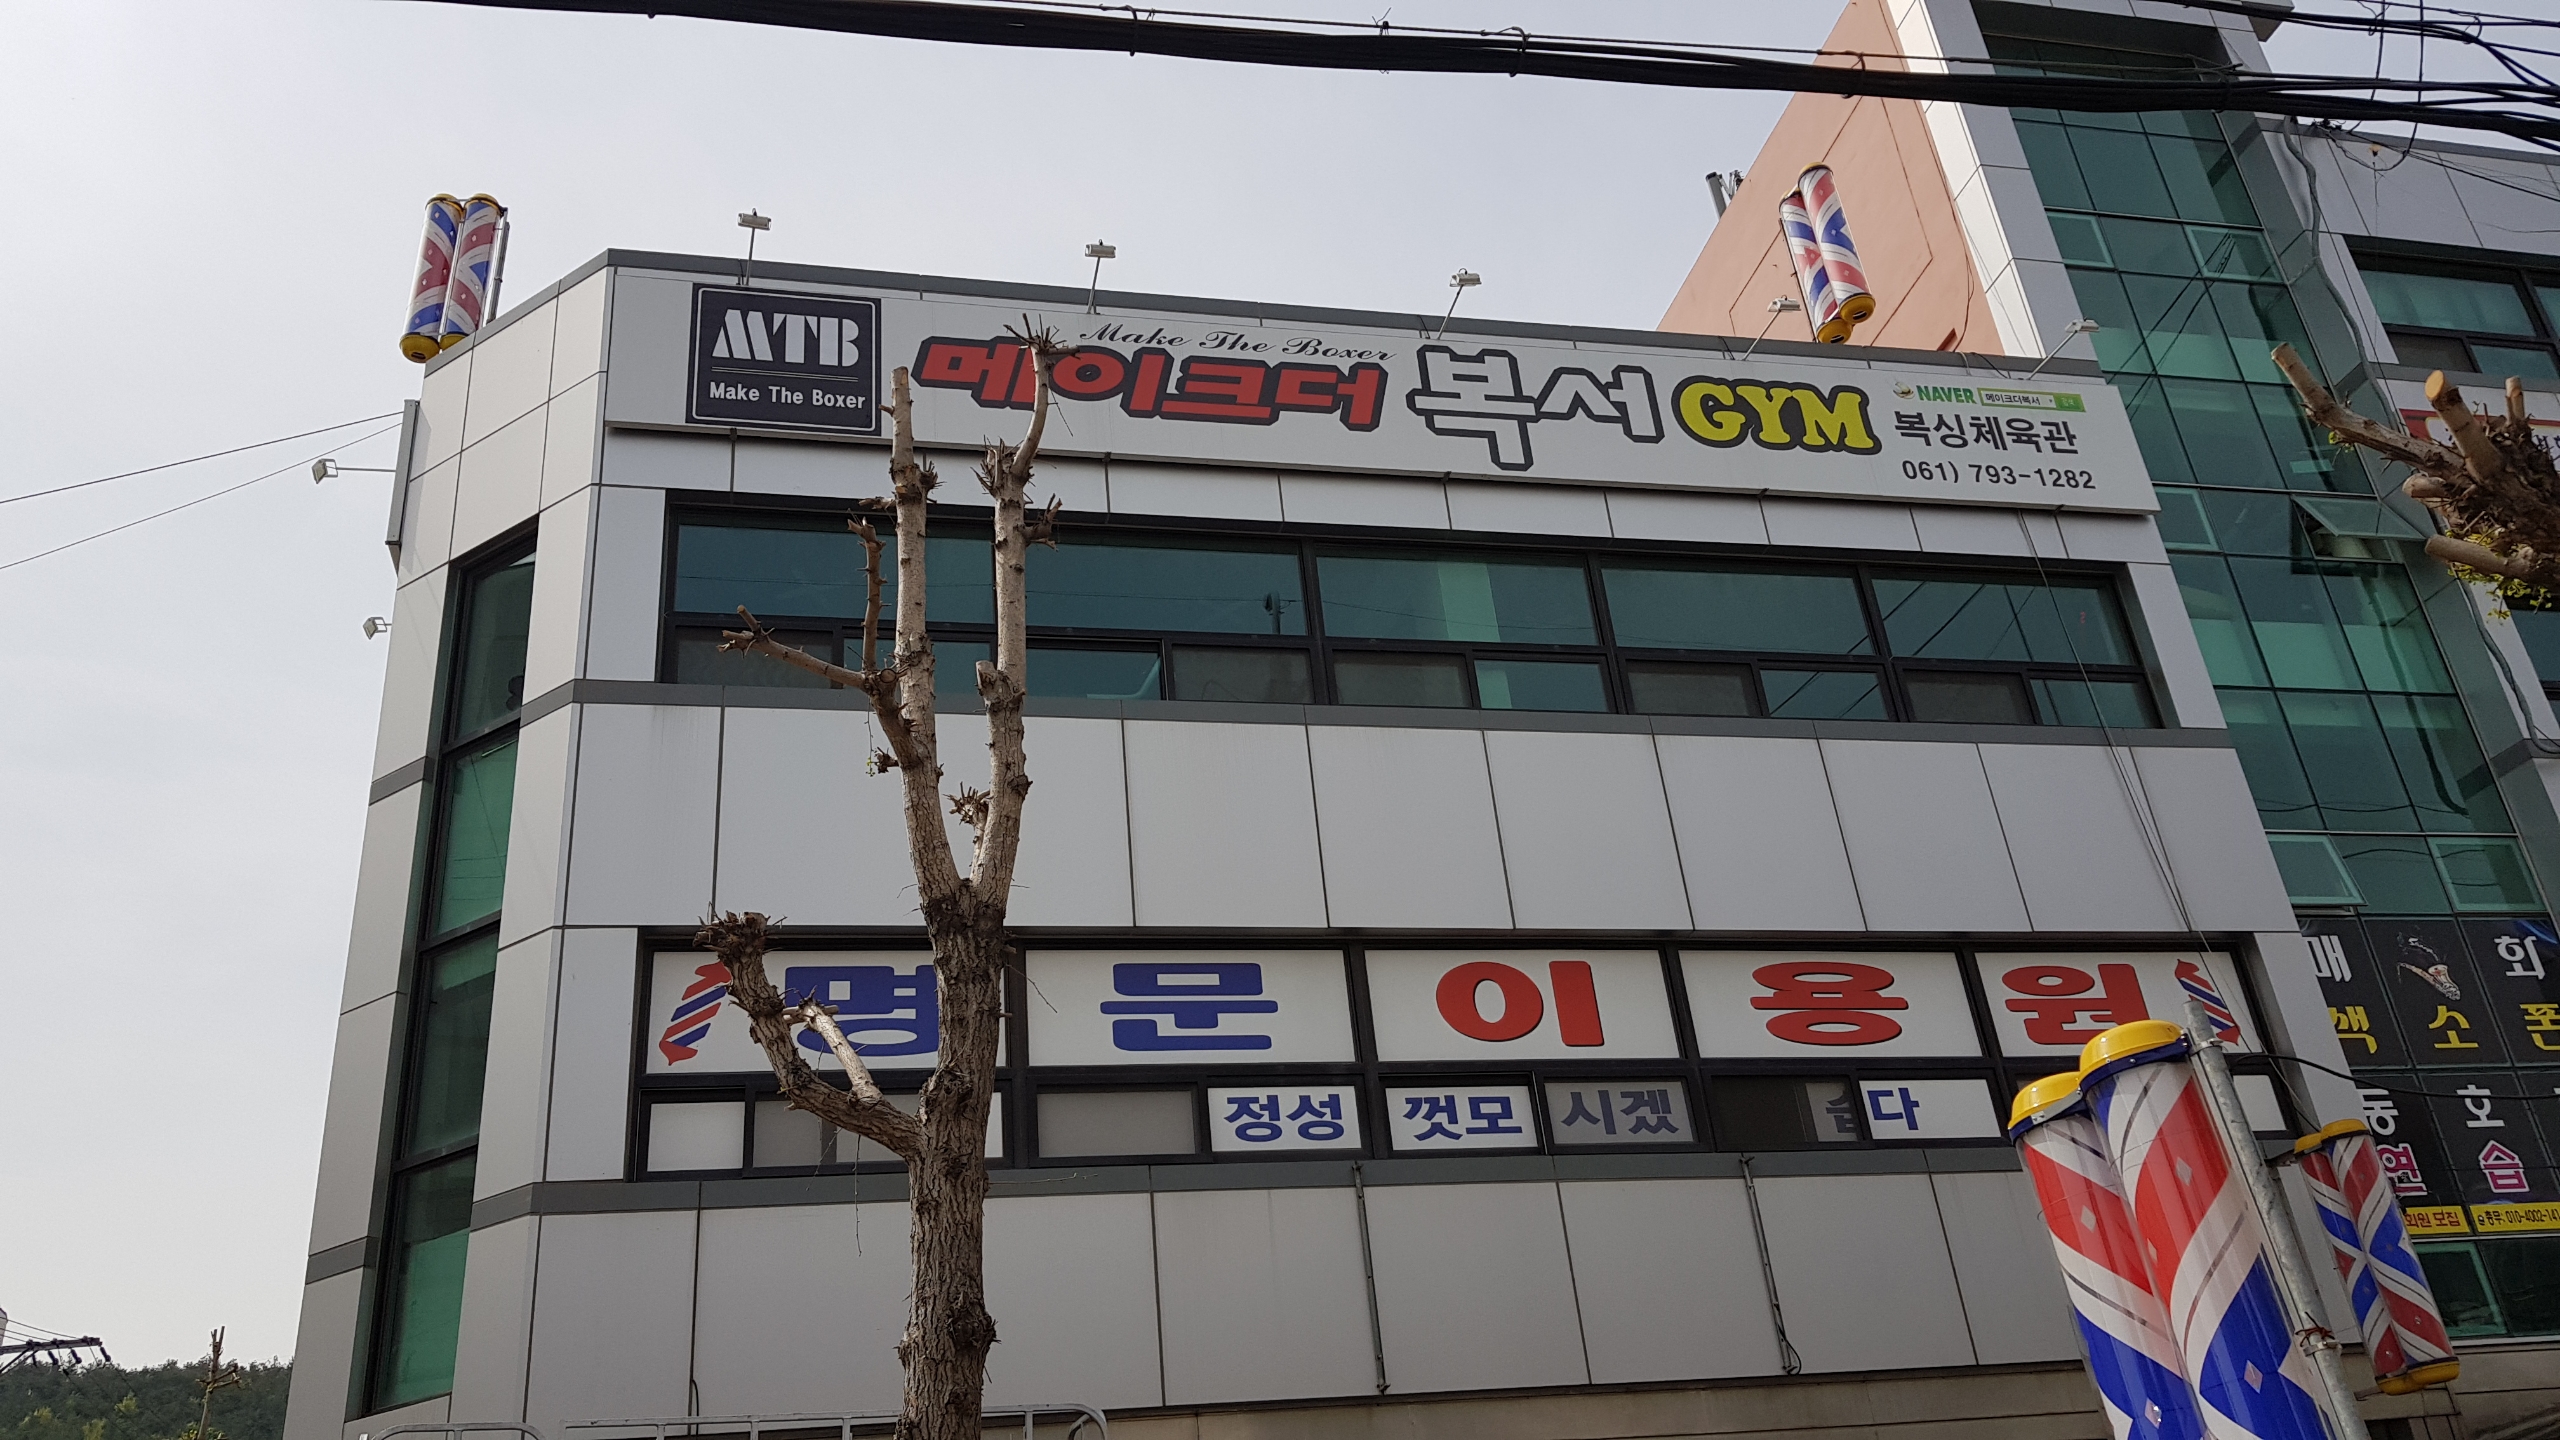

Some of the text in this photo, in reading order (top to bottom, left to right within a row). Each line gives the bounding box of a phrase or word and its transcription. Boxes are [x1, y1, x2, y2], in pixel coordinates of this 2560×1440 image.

[712, 309, 860, 368] MTB
[1080, 323, 1397, 361] Make The Boxer
[709, 381, 866, 409] Make The Boxer
[911, 334, 1882, 472] 메이크더 복서 GYM
[1916, 385, 1978, 404] NAVER
[1894, 410, 2079, 454] 복싱체육관
[1902, 460, 2097, 490] 061) 793-1282
[1100, 962, 1279, 1052] 문
[1436, 960, 1605, 1048] 이
[1750, 961, 1909, 1047] 용
[2428, 1005, 2479, 1049] 소
[1224, 1092, 1346, 1143] 정성
[1402, 1093, 1523, 1141] 껏모
[1560, 1088, 1680, 1136] 시겠
[1866, 1087, 1920, 1131] 다
[2456, 1084, 2505, 1128] 호
[2404, 1210, 2461, 1229] 회원 모집
[2505, 1208, 2560, 1224] 010-4002-141
